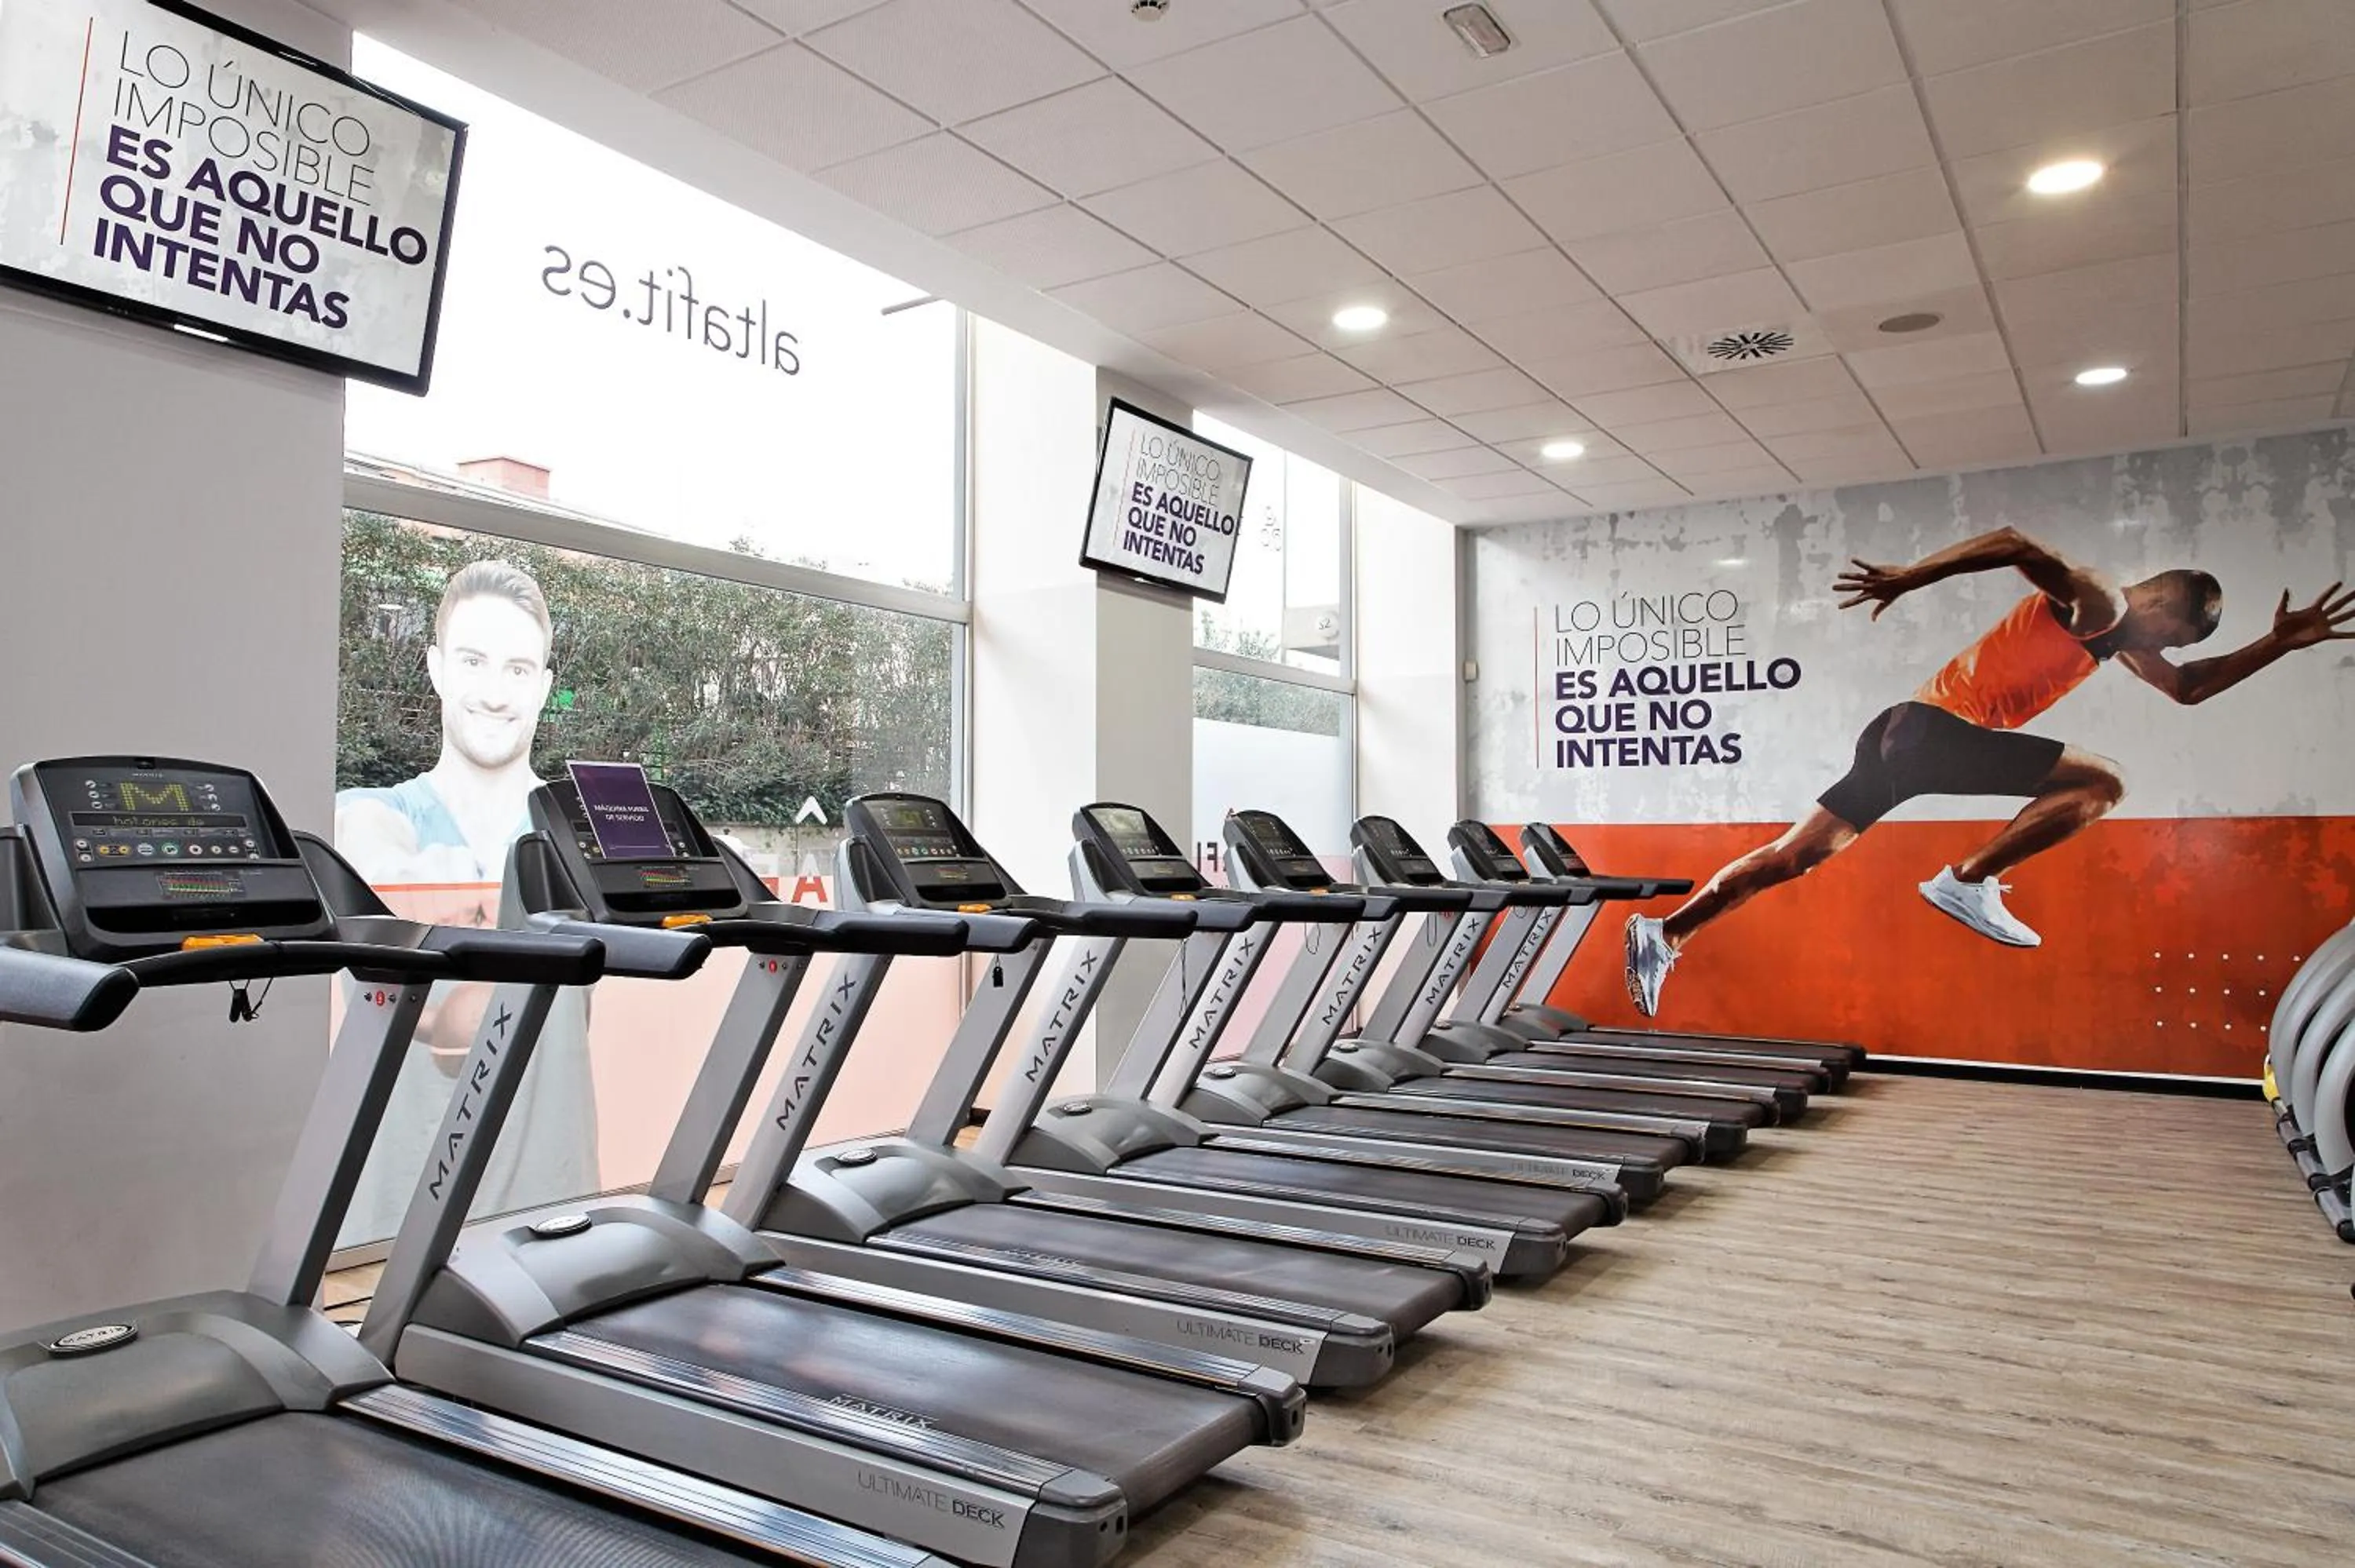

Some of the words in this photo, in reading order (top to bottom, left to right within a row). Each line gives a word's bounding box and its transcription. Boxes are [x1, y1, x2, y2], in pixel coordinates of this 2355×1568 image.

[120, 31, 189, 89] LO
[207, 60, 371, 156] ÚNICO
[115, 78, 374, 206] IMPOSIBLE
[100, 174, 221, 246] QUE
[237, 217, 320, 274] NO
[106, 124, 173, 181] ES
[185, 158, 428, 265] AQUELLO
[93, 217, 350, 330] INTENTAS
[1137, 457, 1219, 506] IMPOSIBLE
[1141, 432, 1163, 459] LO
[1167, 439, 1221, 481] ÚNICO
[1128, 506, 1167, 538] QUE
[1169, 520, 1197, 547] NO
[1131, 481, 1154, 506] ES
[1156, 492, 1235, 536] AQUELLO
[1123, 530, 1205, 574] INTENTAS
[1555, 601, 1601, 633] LO
[1612, 590, 1739, 629] ÚNICO
[1557, 625, 1747, 666] IMPOSIBLE
[1555, 669, 1597, 700] ES
[1608, 658, 1802, 697] AQUELLO
[1555, 702, 1637, 733] QUE
[1648, 698, 1712, 731] NO
[1556, 732, 1743, 768] INTENTAS
[1322, 925, 1382, 1026] MATRIX
[1425, 917, 1481, 1006] MATRIX
[1502, 911, 1553, 988] MATRIX
[1024, 949, 1098, 1083] MATRIX
[1188, 937, 1254, 1050] MATRIX
[776, 971, 856, 1131] MATRIX
[429, 1002, 512, 1202] MATRIX
[1456, 1234, 1495, 1250] DECK
[1177, 1318, 1256, 1347] ULTIMATE
[1258, 1333, 1305, 1355] DECK
[857, 1469, 948, 1512] ULTIMATE
[951, 1498, 1006, 1530] DECK
